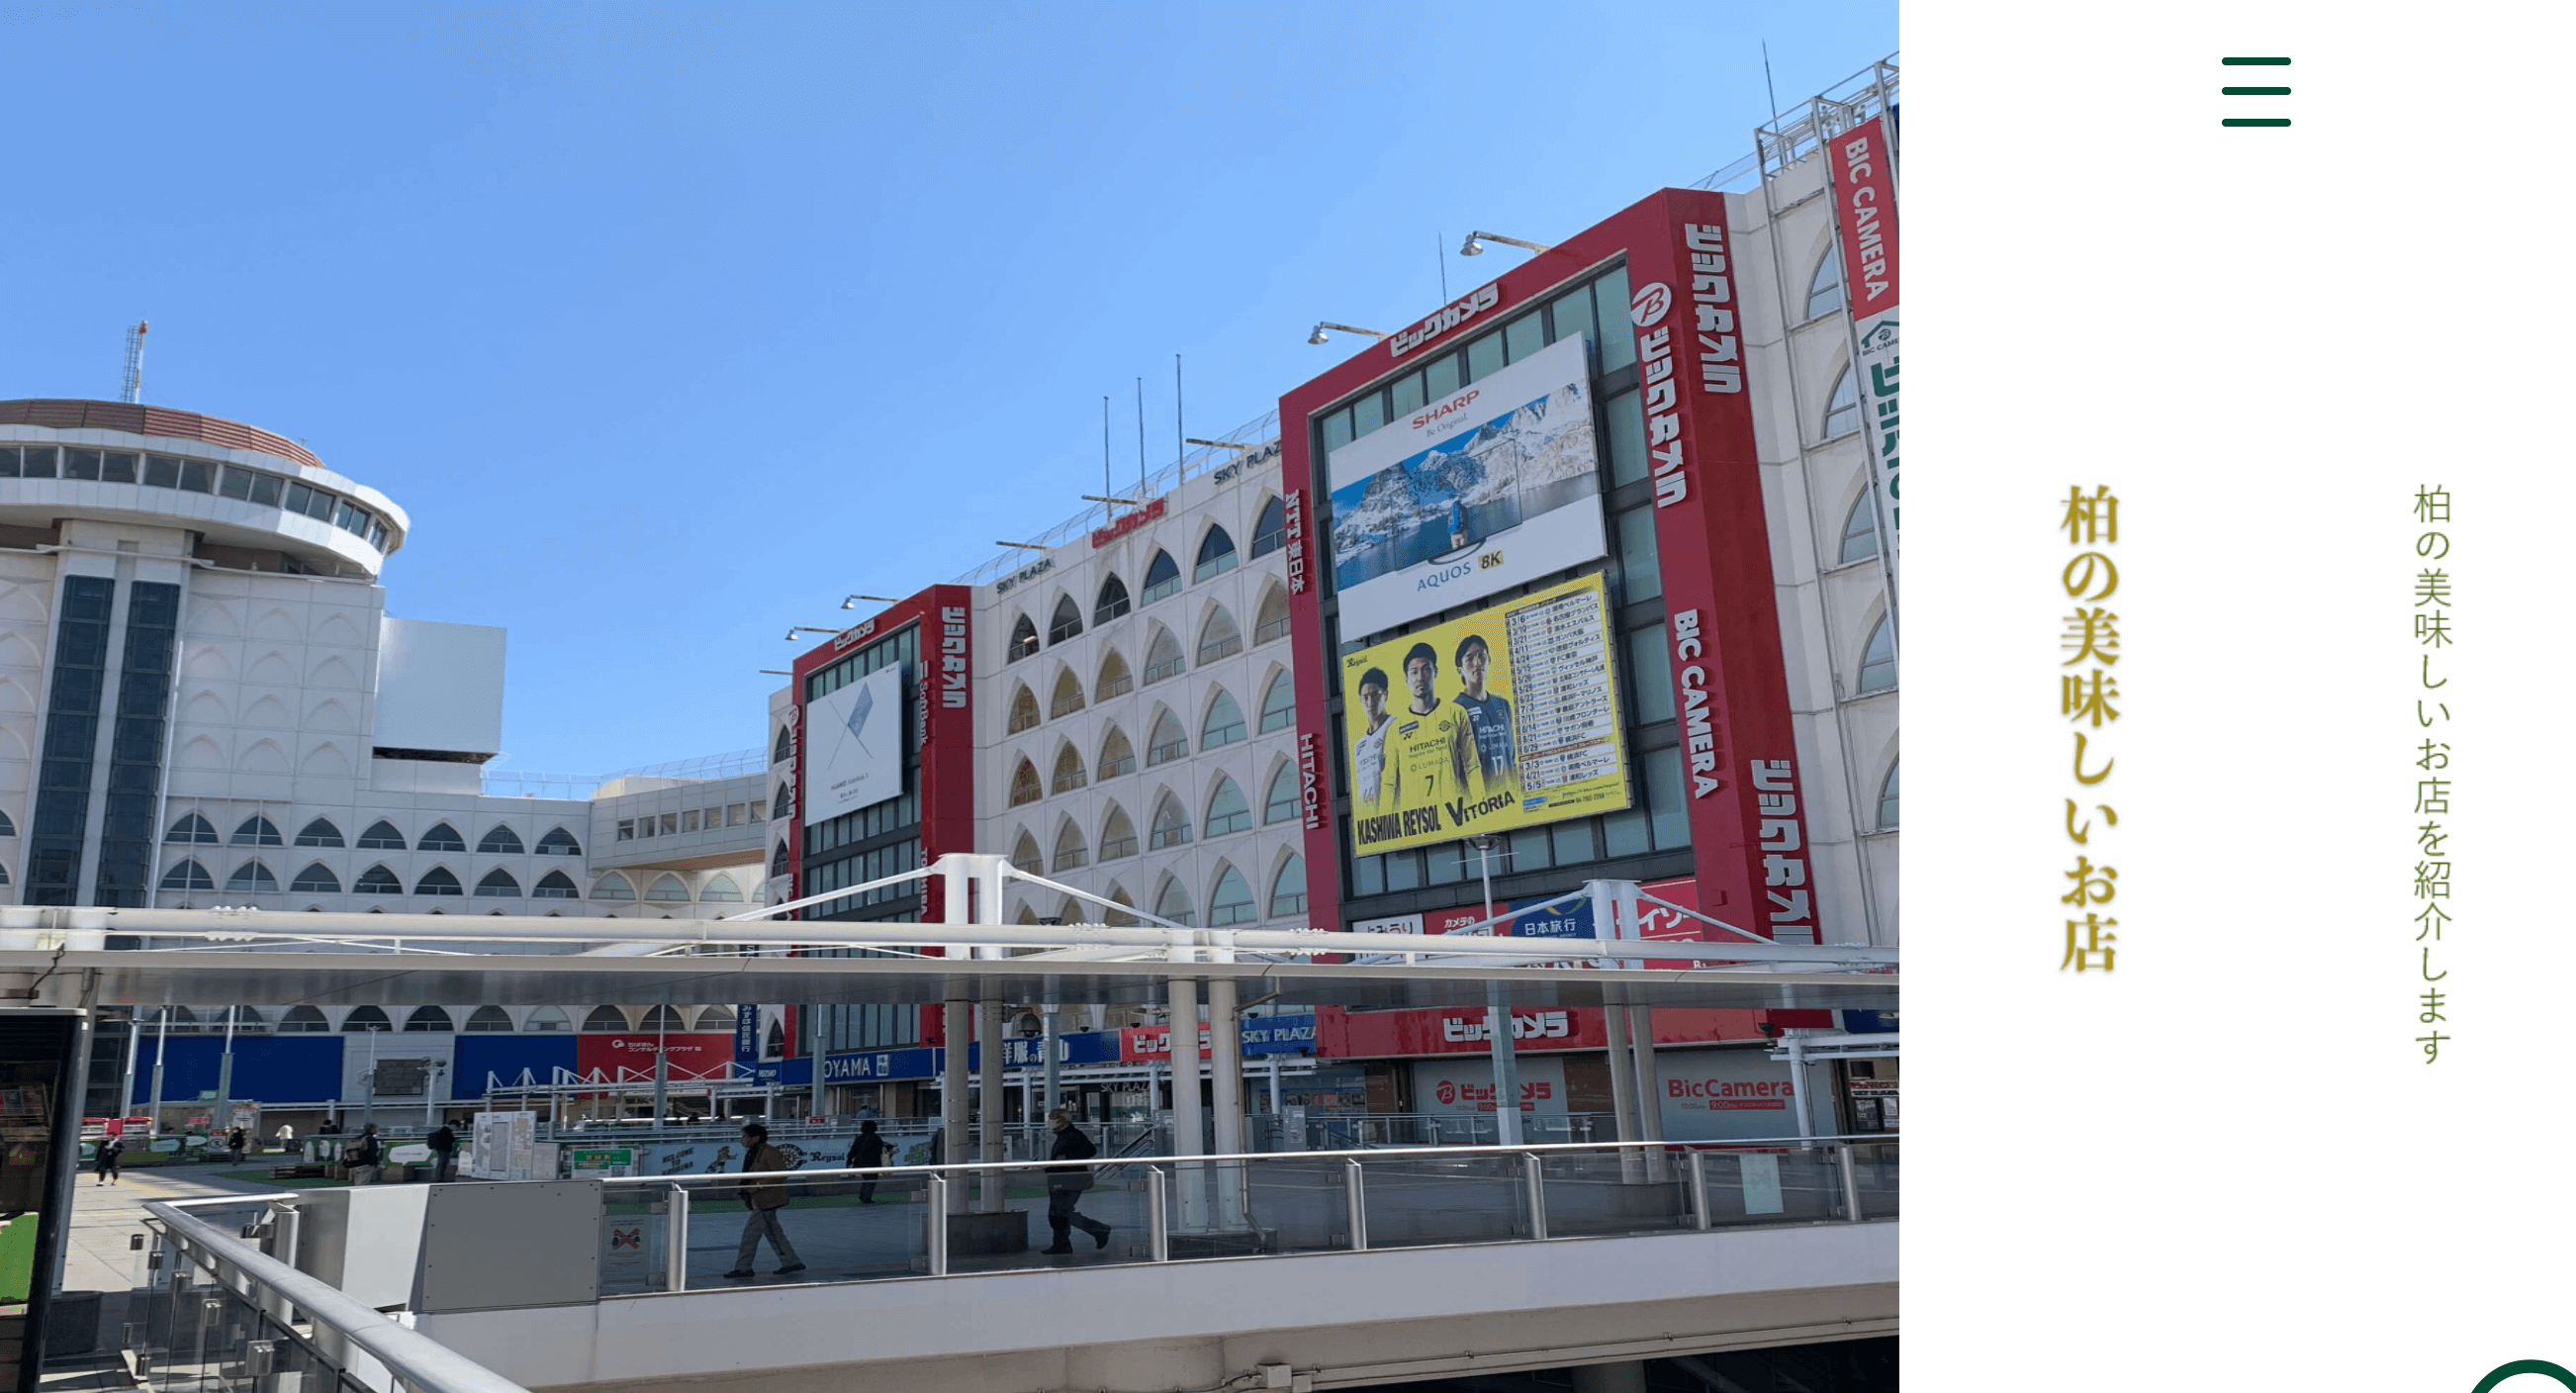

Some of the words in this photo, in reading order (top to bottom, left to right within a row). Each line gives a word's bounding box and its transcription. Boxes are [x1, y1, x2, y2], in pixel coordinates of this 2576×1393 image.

[1845, 136, 1871, 185] BIC
[1853, 186, 1889, 301] CAMERA
[1390, 282, 1499, 357] ビックカメラ
[1685, 223, 1742, 394] ビックカメラ
[1413, 390, 1480, 429] SHARP
[1639, 325, 1687, 508] ビックカメラ
[1214, 460, 1242, 485] SKY
[1245, 439, 1282, 469] PLAZ
[996, 575, 1017, 595] SKY
[1019, 557, 1055, 583] PLAZA
[1417, 562, 1471, 592] AQUOS
[1481, 550, 1502, 570] 8K
[1512, 615, 1525, 626] 3/6
[1674, 608, 1702, 661] BIC
[942, 606, 966, 708] ビックカメラ
[1410, 737, 1446, 753] HITACHI
[1681, 665, 1719, 799] CAMERA
[1300, 732, 1320, 830] HITACHI
[1425, 775, 1434, 797] 7
[1526, 781, 1541, 790] 5/5
[1357, 812, 1402, 845] KASHIWA
[1403, 804, 1441, 839] REYSOL
[1443, 916, 1475, 928] カメラの
[1524, 918, 1576, 936] 日本旅行
[1242, 1029, 1269, 1044] SKY
[1273, 1025, 1317, 1042] PLAZA
[823, 1057, 872, 1077] OYAMA
[1101, 1081, 1119, 1093] SKY
[1460, 1082, 1551, 1100] ビックメラ
[1668, 1078, 1794, 1098] BicCamera
[810, 1151, 846, 1163] Reysol
